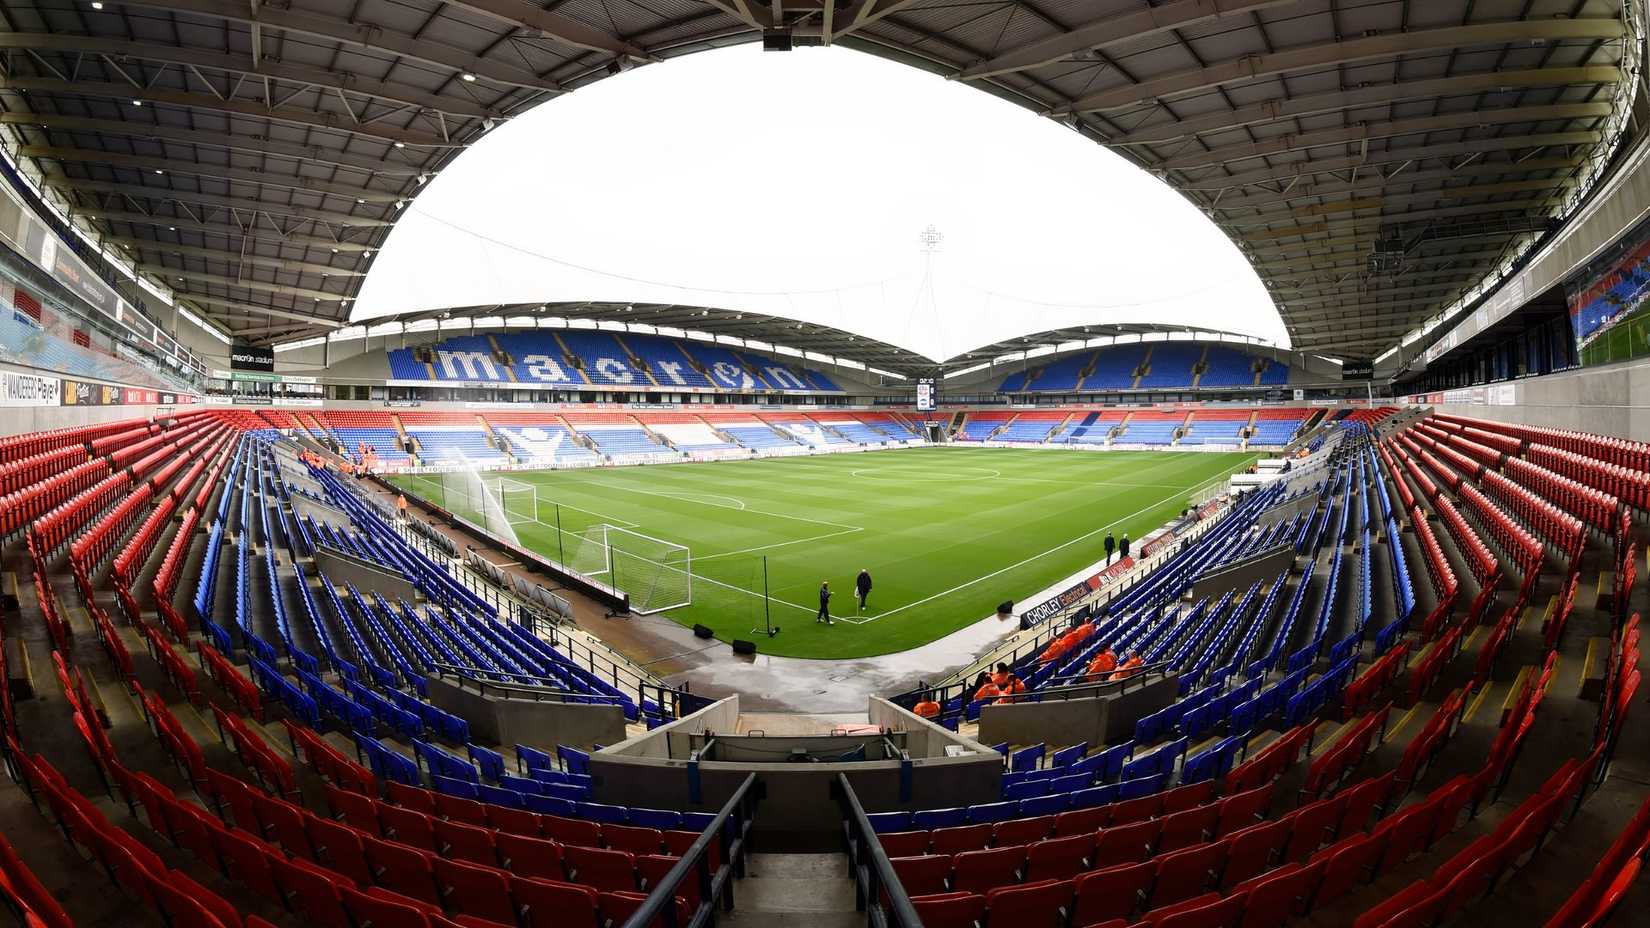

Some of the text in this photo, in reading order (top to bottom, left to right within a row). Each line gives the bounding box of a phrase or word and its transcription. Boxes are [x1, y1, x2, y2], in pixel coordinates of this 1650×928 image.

[232, 354, 255, 362] macron
[437, 348, 806, 391] macron
[8, 373, 37, 400] WANDERERS
[37, 377, 55, 405] Player
[1027, 597, 1062, 625] CHORLEY
